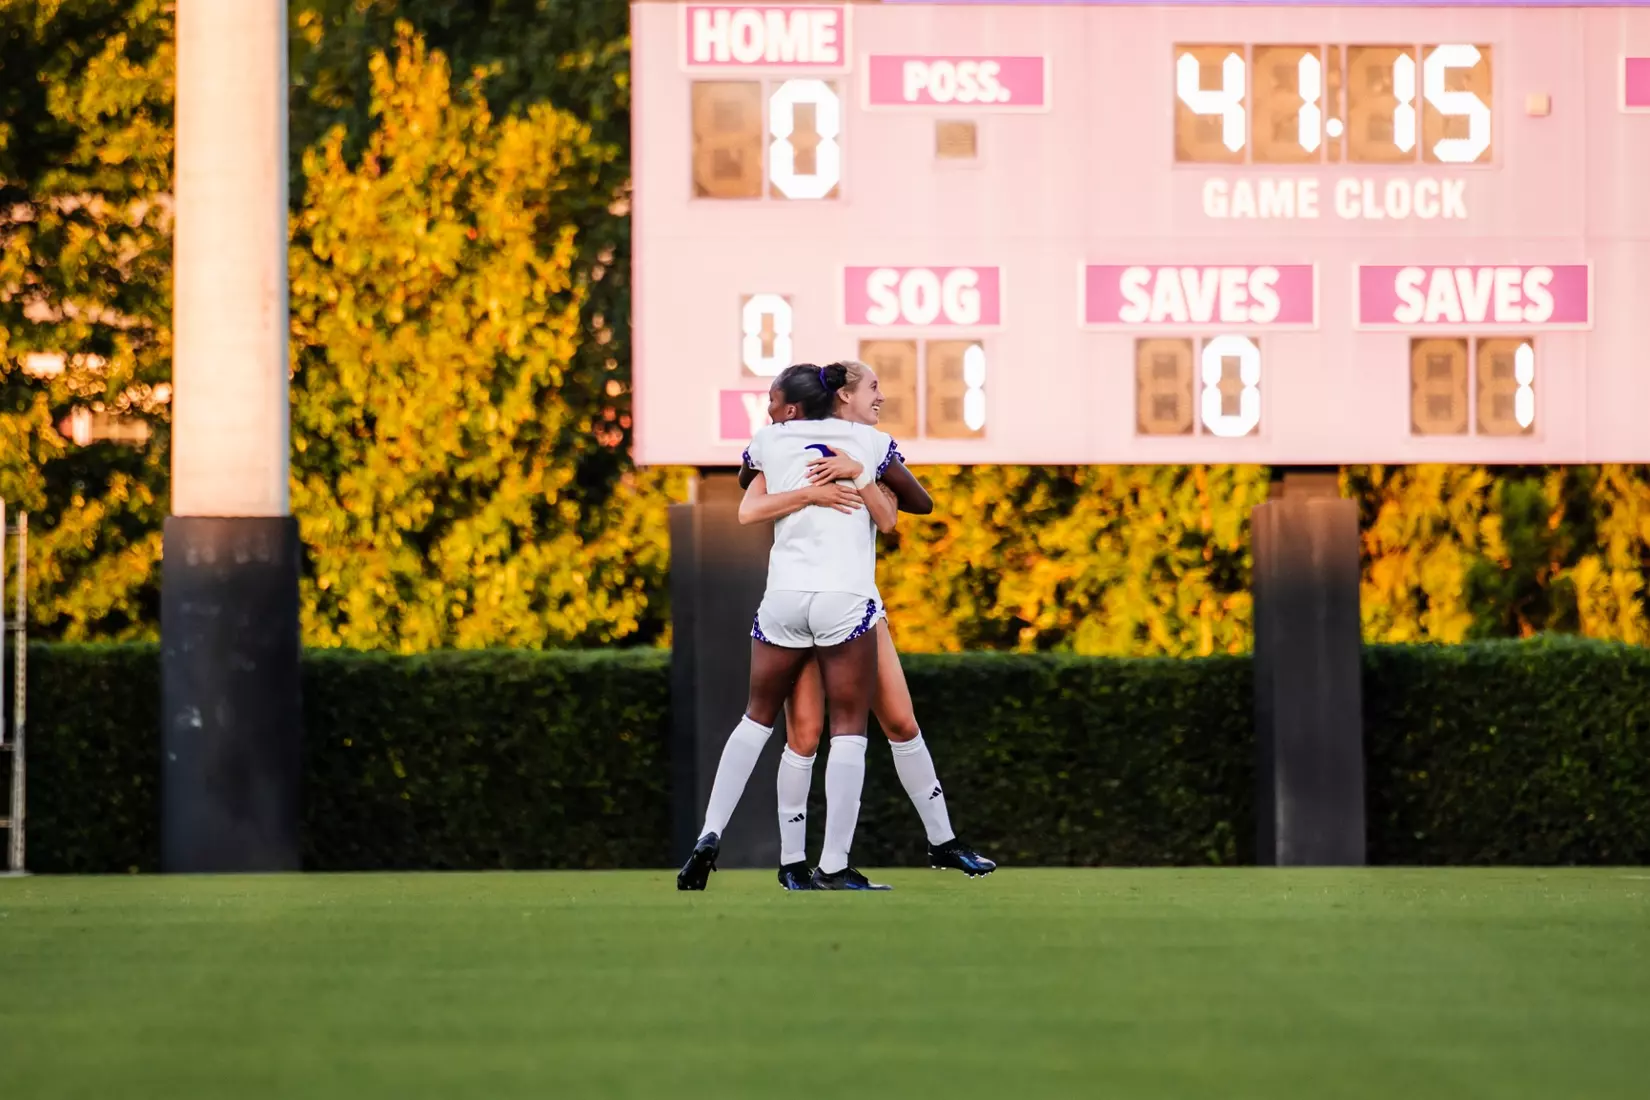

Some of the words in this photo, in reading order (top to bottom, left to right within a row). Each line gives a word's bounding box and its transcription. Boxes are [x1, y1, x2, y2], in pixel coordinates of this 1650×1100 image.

[694, 10, 838, 63] HOME
[903, 60, 1011, 103] POSS.
[769, 79, 840, 199] 0
[1203, 178, 1320, 219] GAME
[1335, 178, 1468, 219] CLOCK
[866, 268, 981, 325] SOG
[1119, 266, 1280, 323] SAVES
[1394, 266, 1555, 323] SAVES
[742, 294, 793, 377] 0
[964, 345, 986, 431] 1
[1201, 335, 1260, 437] 0
[1515, 343, 1535, 428] 1
